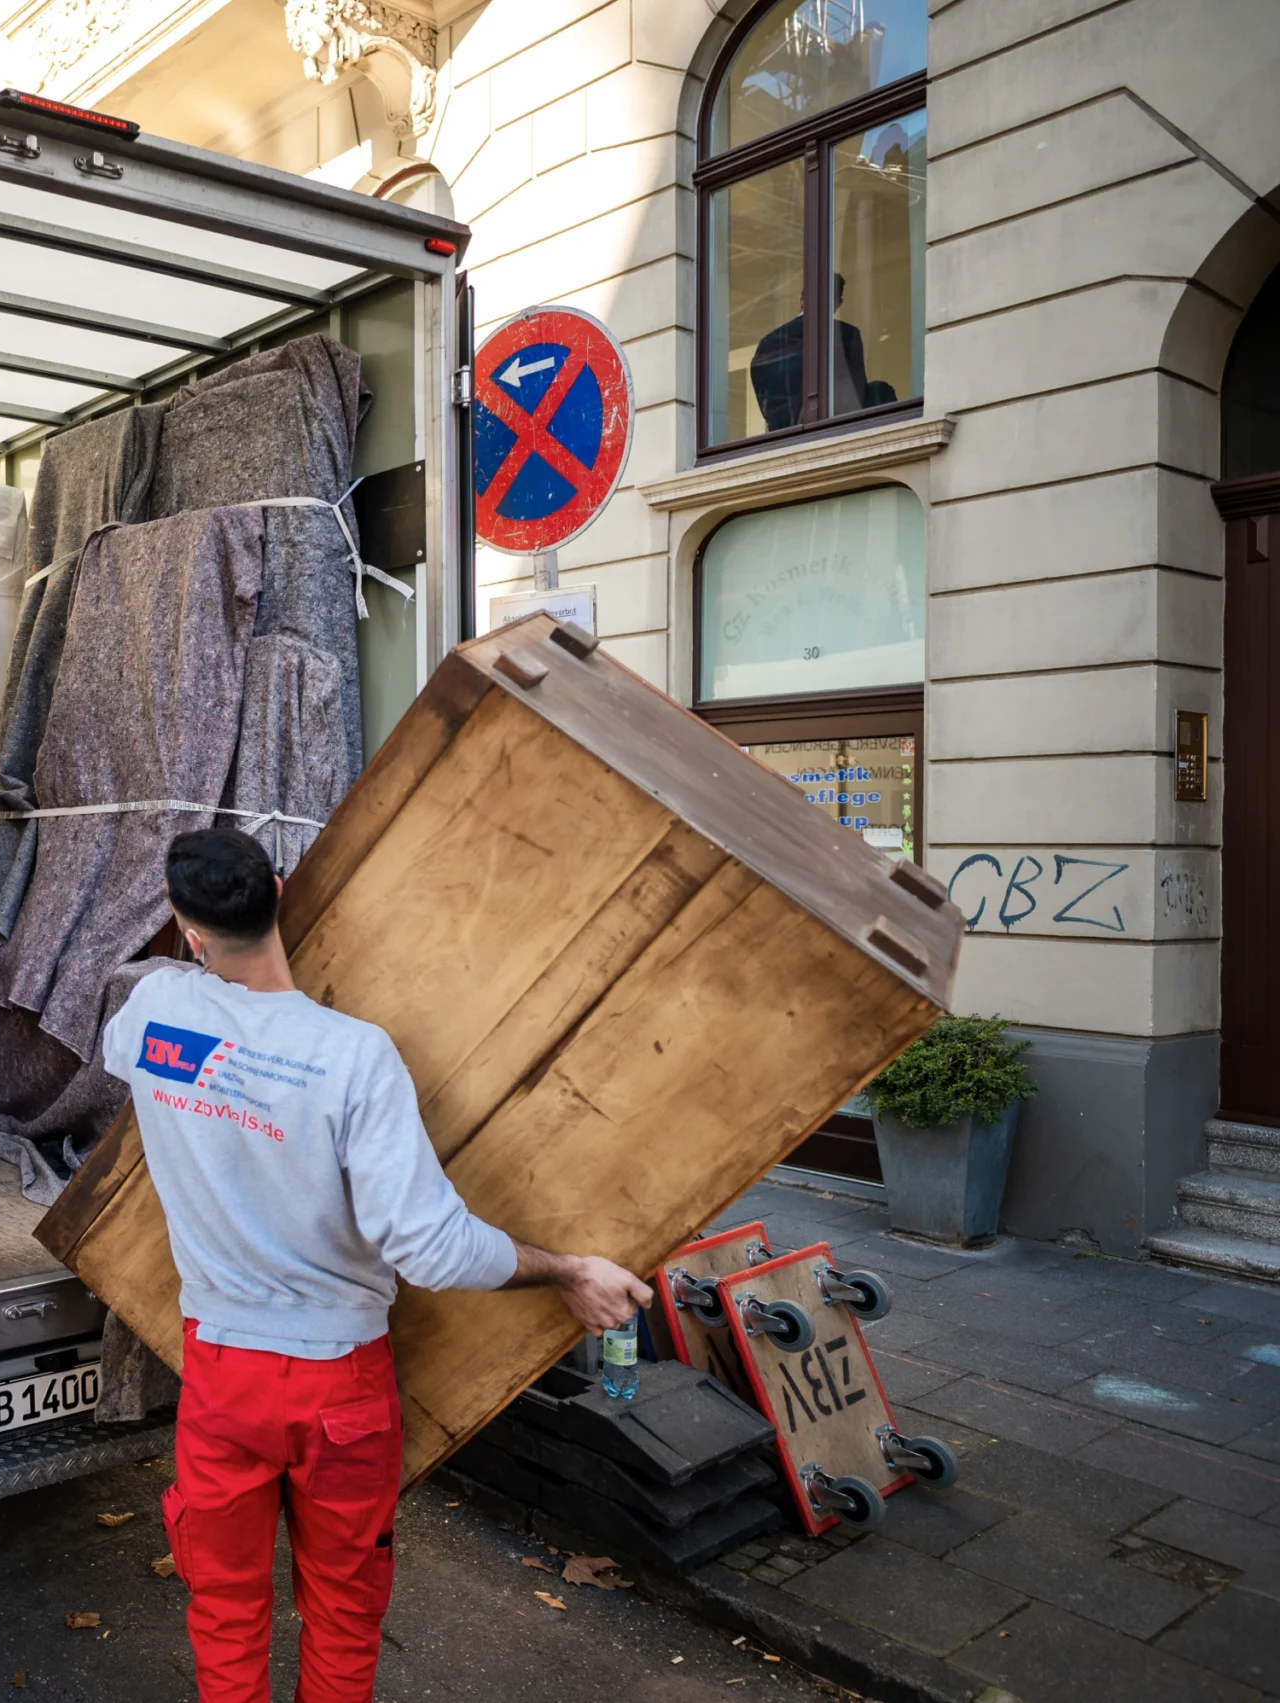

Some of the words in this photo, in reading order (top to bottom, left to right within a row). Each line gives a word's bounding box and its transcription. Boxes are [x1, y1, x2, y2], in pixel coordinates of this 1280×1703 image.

[803, 646, 820, 661] 30
[146, 1036, 182, 1068] ZBV
[152, 1088, 285, 1143] www.zbvfels.de
[21, 1369, 99, 1422] 1400
